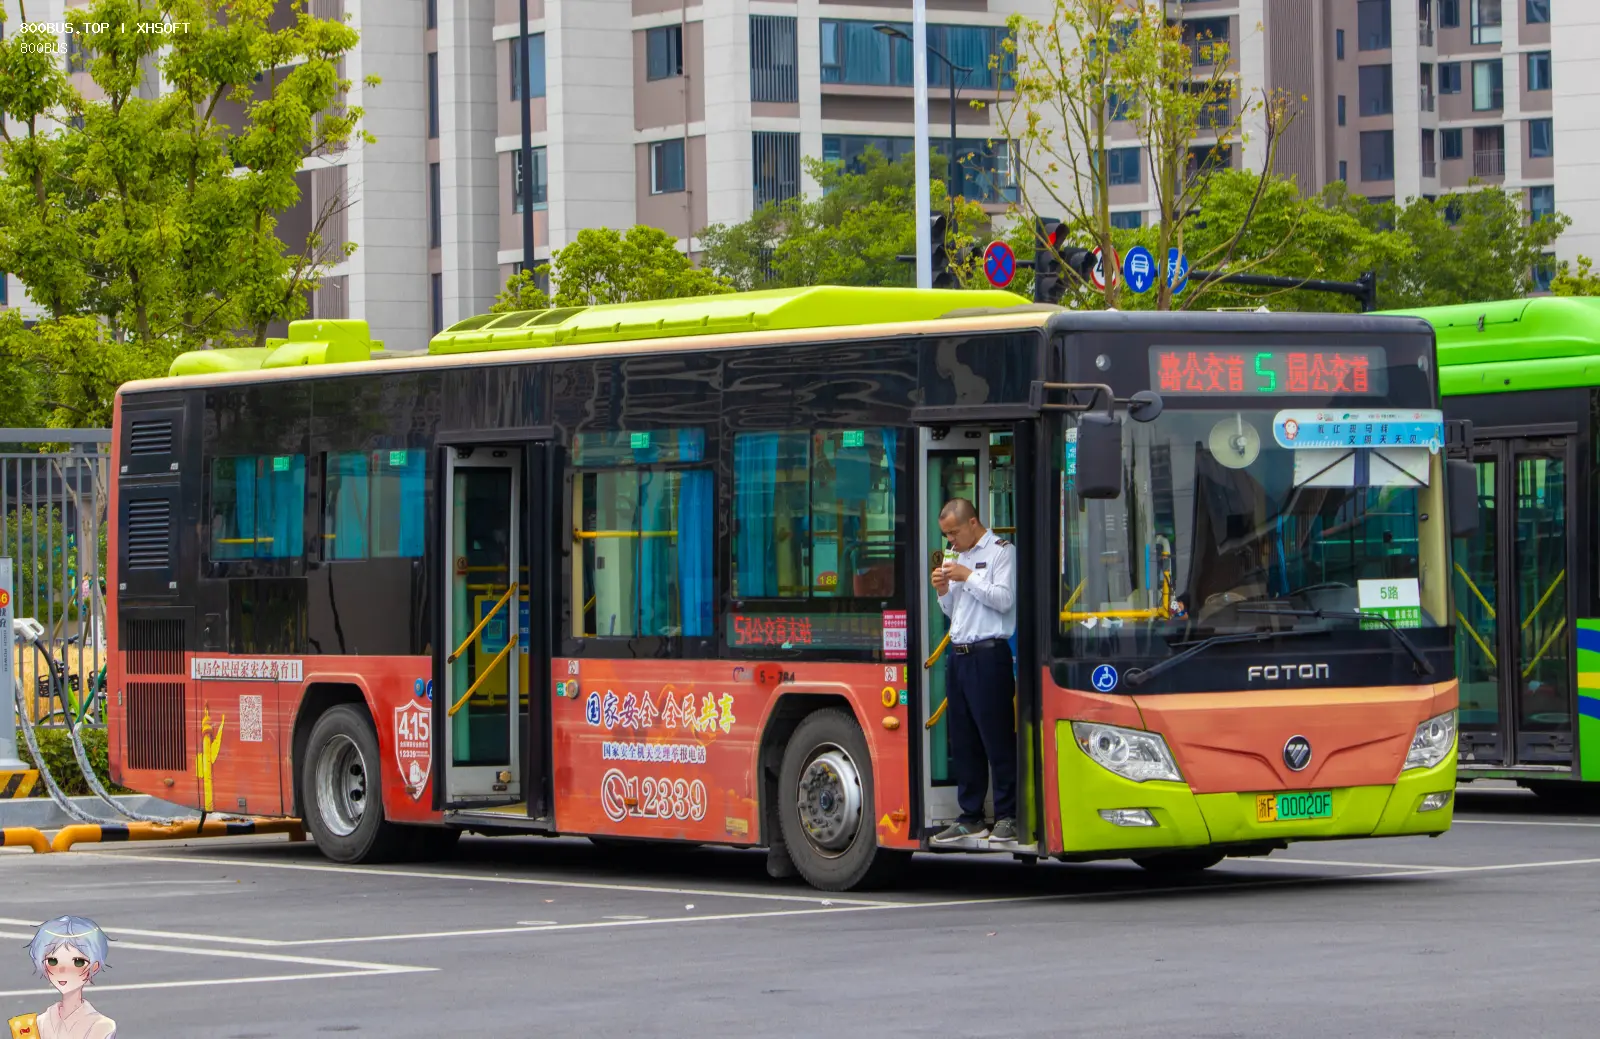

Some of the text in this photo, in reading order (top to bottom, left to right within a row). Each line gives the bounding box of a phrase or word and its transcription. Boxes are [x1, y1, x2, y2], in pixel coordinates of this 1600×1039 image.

[1255, 352, 1277, 392] 5
[1347, 434, 1418, 445] 文明天天见
[1380, 586, 1399, 600] 5路
[196, 660, 299, 679] 4.15全民国家安全教育日
[1247, 663, 1330, 682] FOTON
[585, 689, 736, 734] 国家安全 全民共享
[398, 711, 429, 741] 4.15
[602, 741, 706, 764] 国家安全机关受理举报电话
[628, 775, 707, 821] 12339
[1281, 794, 1331, 817] 00020F
